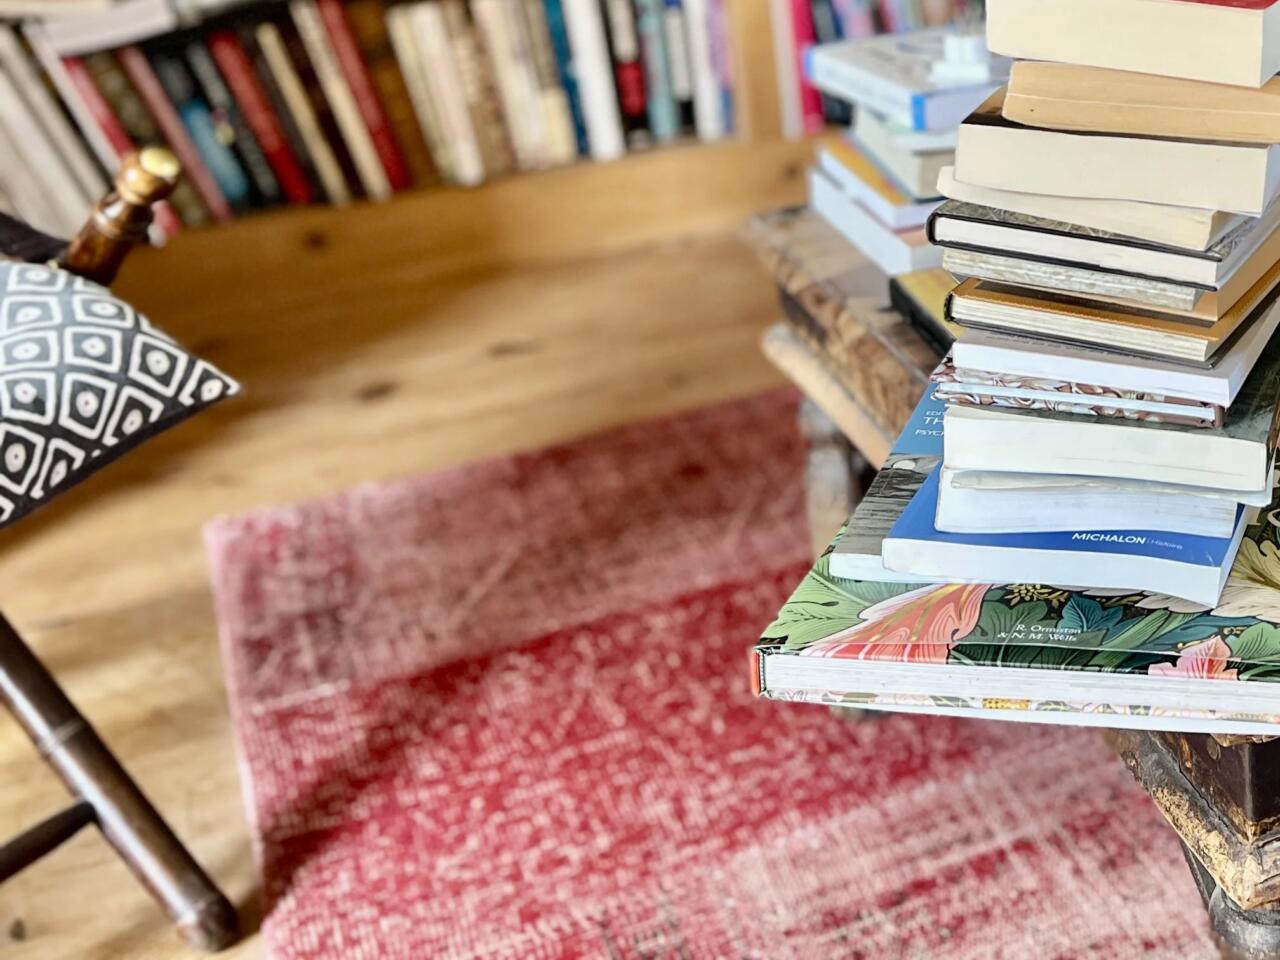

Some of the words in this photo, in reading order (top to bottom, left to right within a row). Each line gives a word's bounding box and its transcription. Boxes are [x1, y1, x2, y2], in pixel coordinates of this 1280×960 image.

[1072, 532, 1146, 545] MICHALON
[1016, 623, 1027, 632] R.
[1031, 624, 1082, 634] Ormiston
[1049, 633, 1077, 641] Wells
